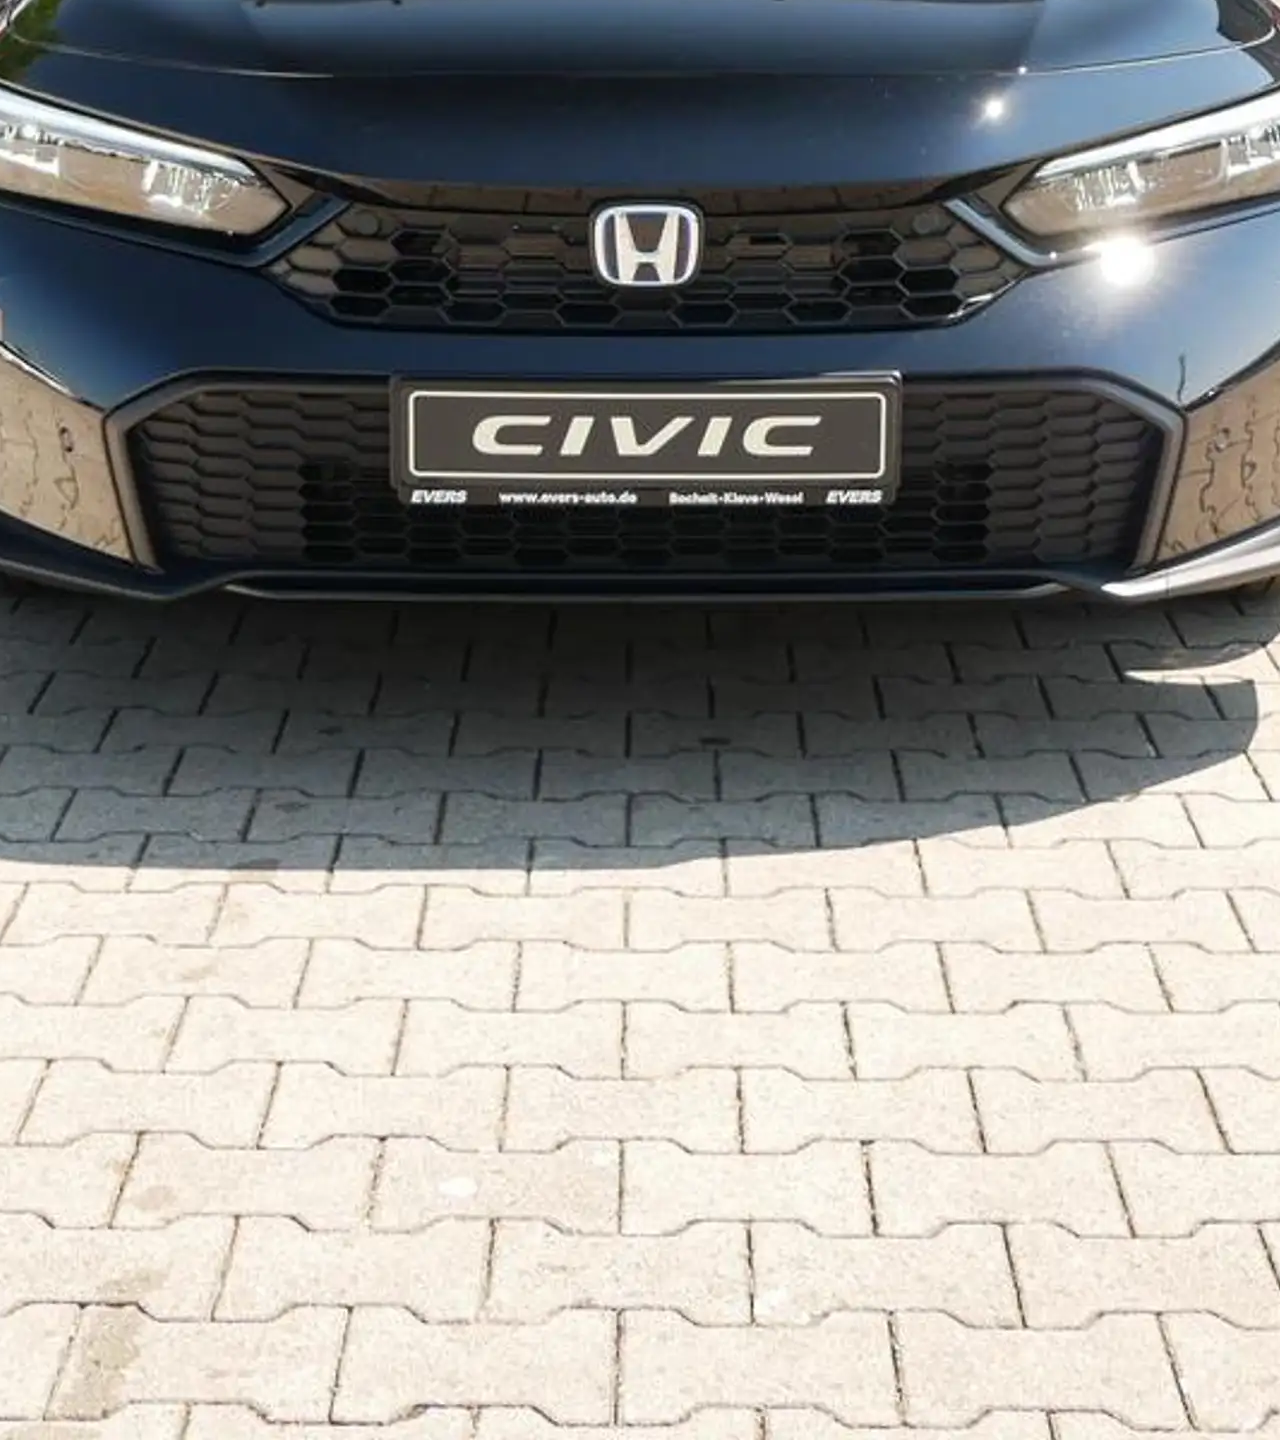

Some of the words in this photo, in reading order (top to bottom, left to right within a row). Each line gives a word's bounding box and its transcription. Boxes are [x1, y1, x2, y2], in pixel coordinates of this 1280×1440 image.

[472, 415, 822, 456] CIVIC
[410, 490, 468, 504] EVERS
[498, 490, 638, 505] www.evers-auto.de
[825, 490, 883, 504] EVERS
